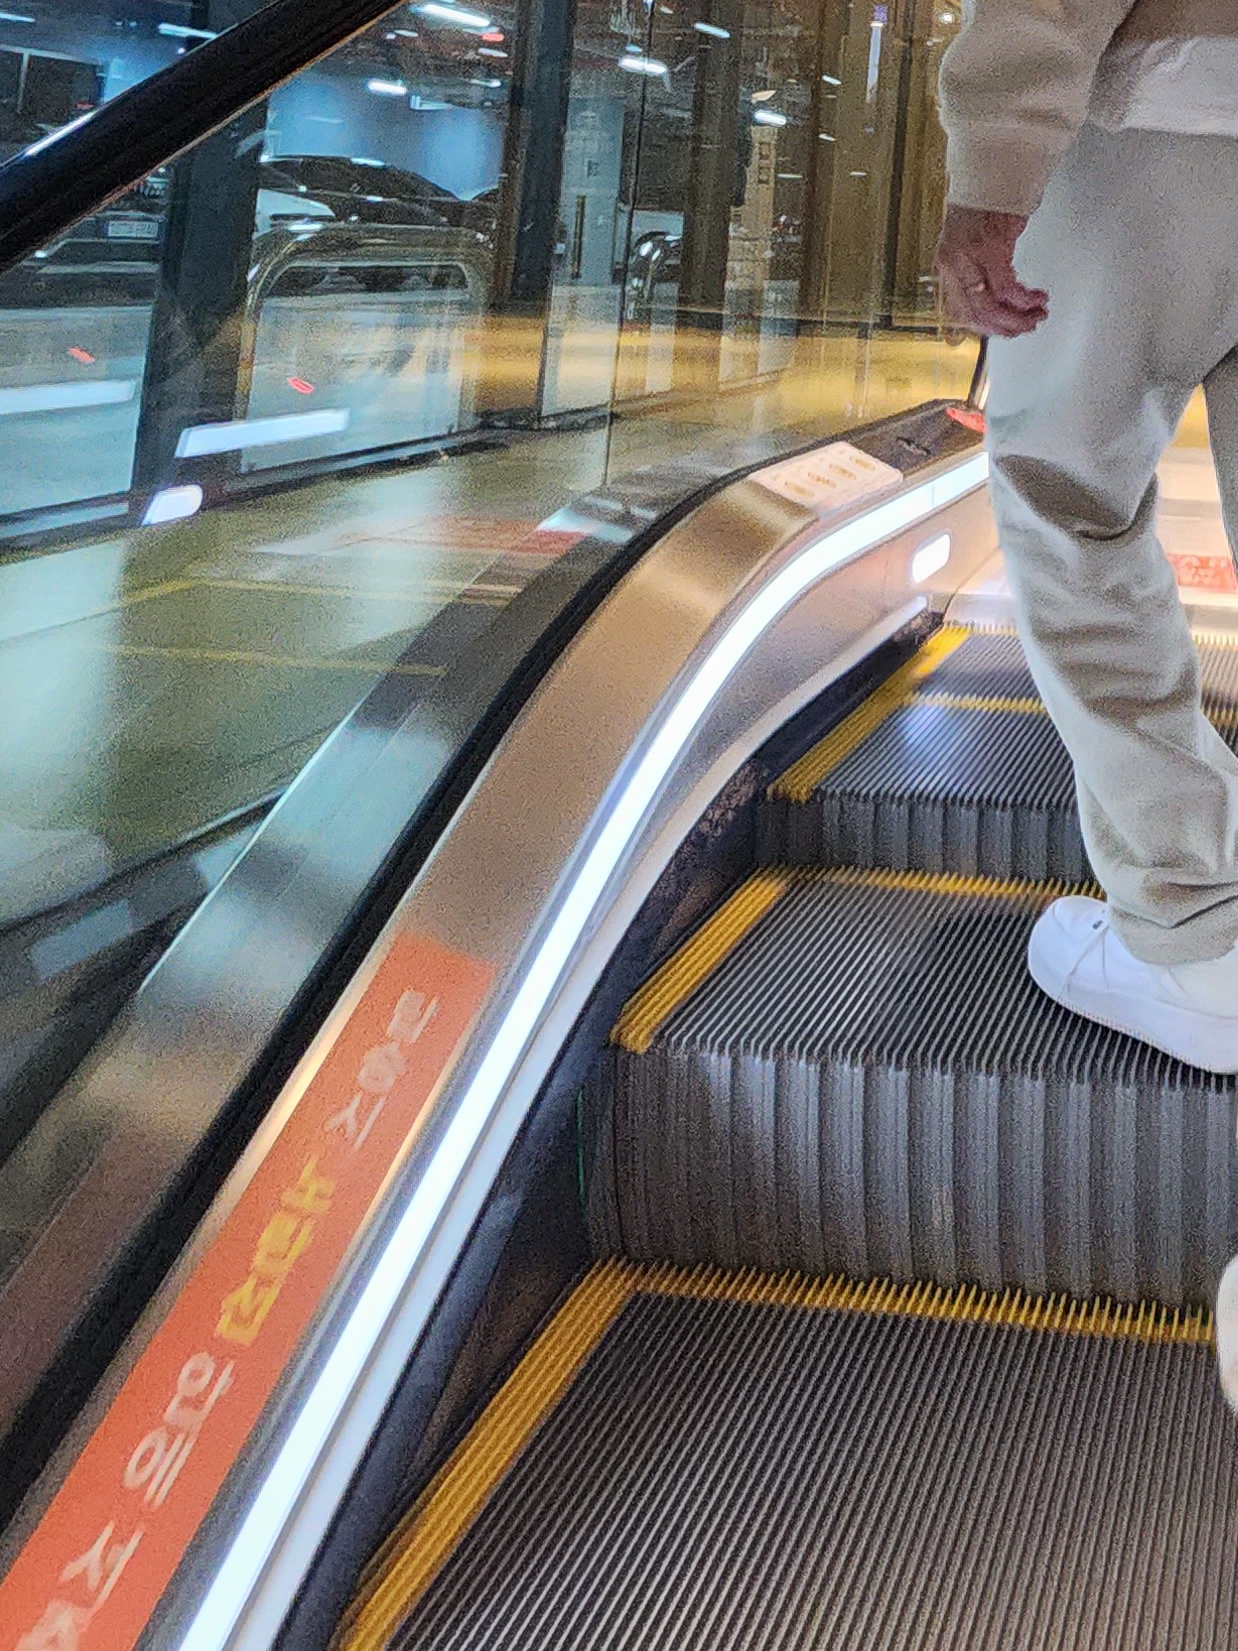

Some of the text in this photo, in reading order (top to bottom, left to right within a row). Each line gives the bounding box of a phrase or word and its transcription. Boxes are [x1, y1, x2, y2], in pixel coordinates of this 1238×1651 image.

[324, 989, 442, 1151] 탑승시
[213, 1152, 337, 1346] 노란선
[123, 1350, 236, 1508] 안에
